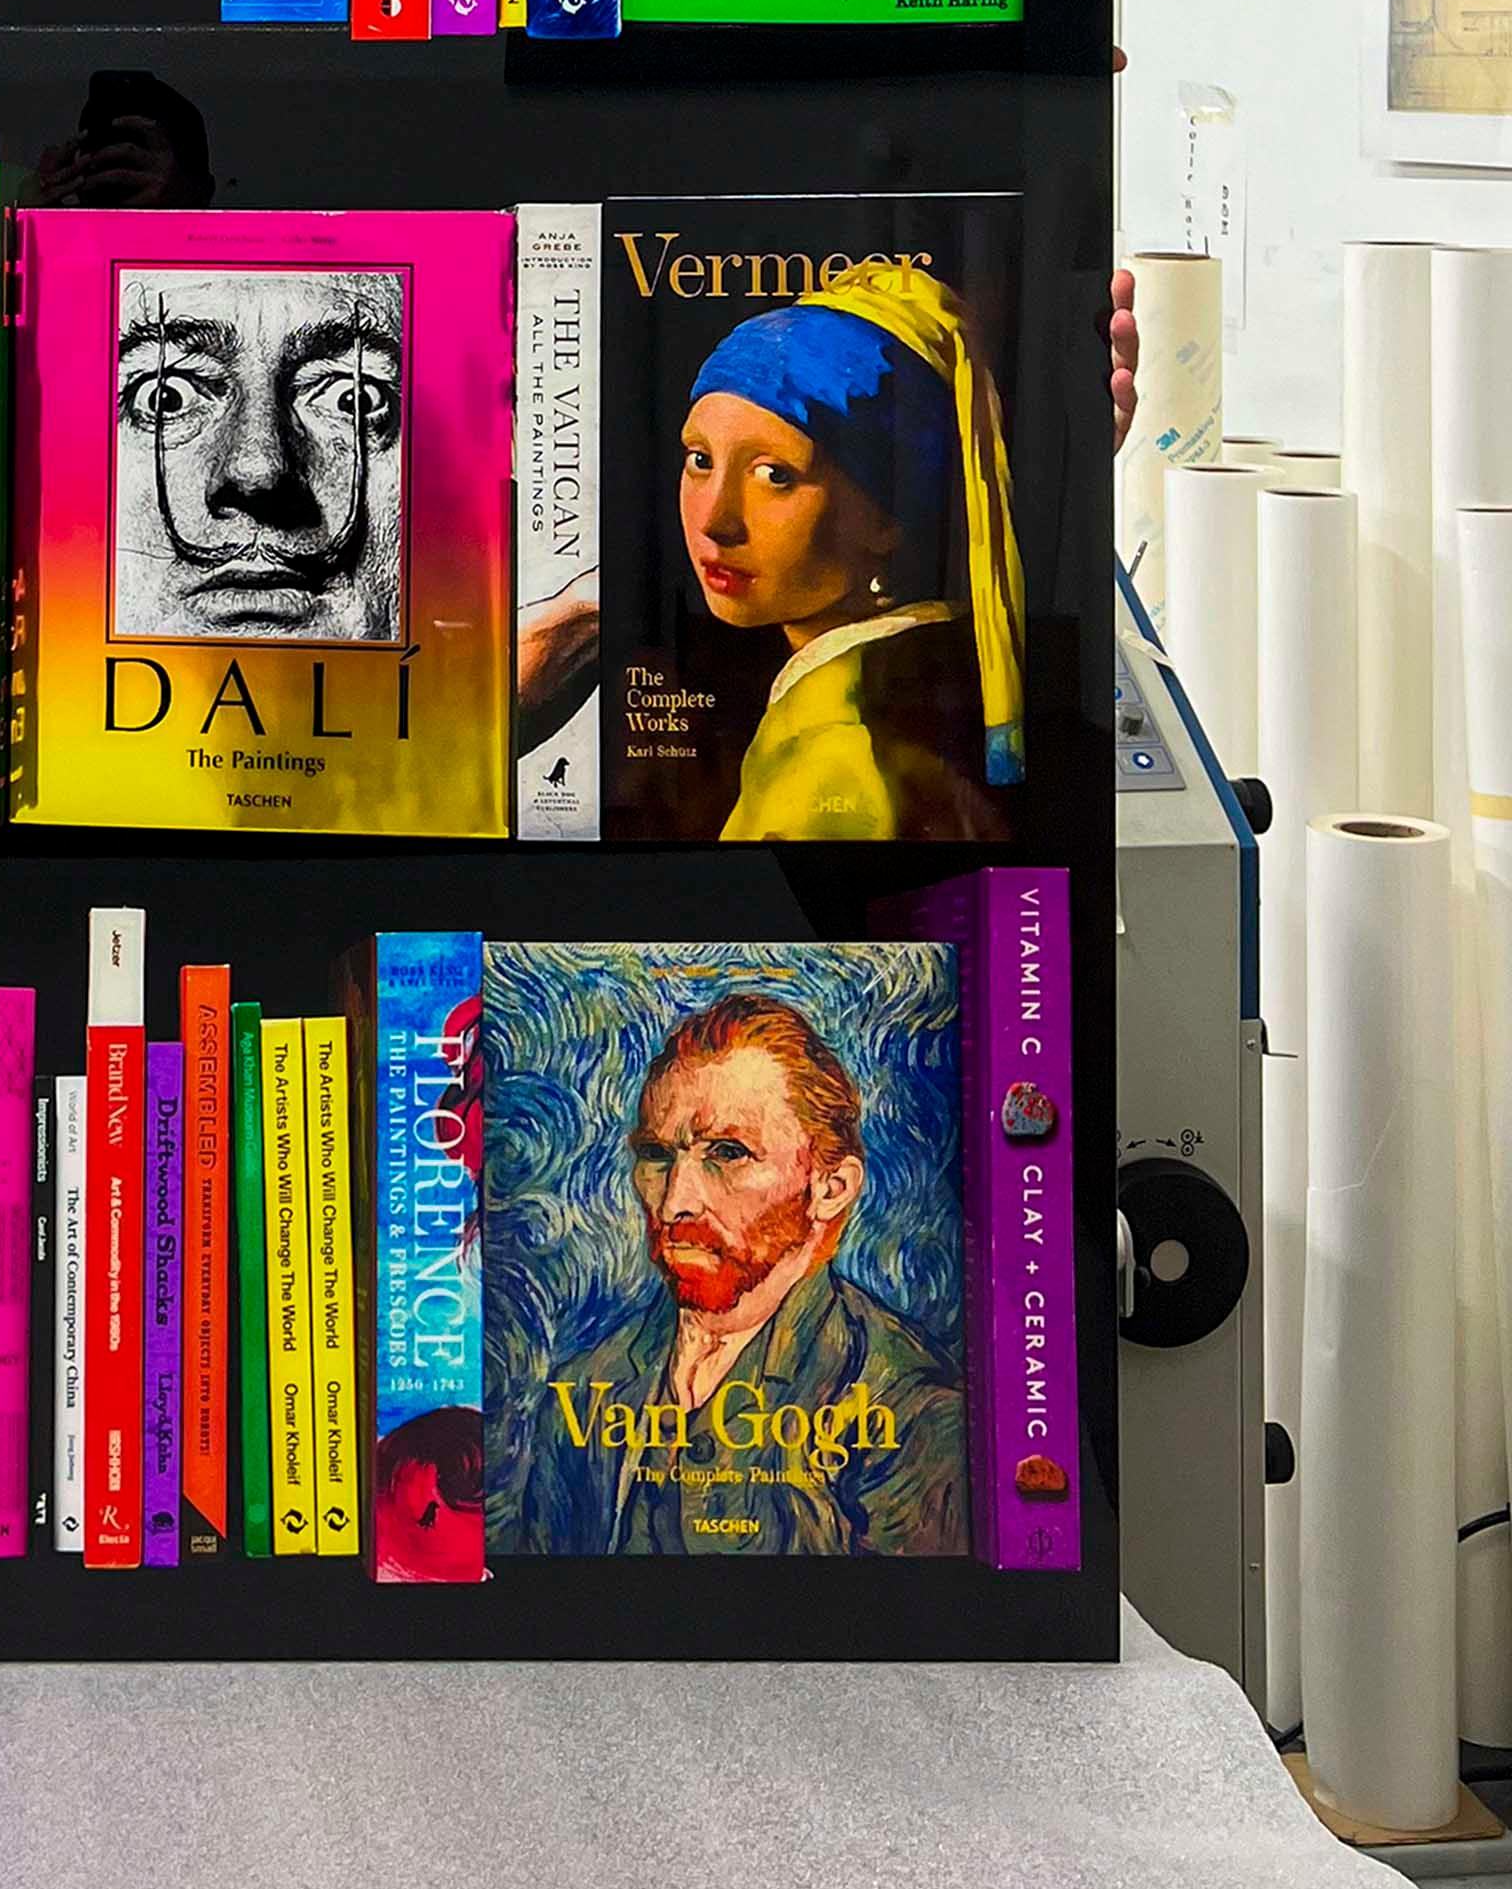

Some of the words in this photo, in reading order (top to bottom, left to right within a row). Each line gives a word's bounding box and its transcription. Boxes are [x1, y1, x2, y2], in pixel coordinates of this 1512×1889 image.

[614, 233, 932, 297] Vermeer
[532, 315, 543, 353] ALL
[554, 290, 580, 371] THE
[532, 362, 543, 403] THE
[532, 414, 543, 532] PAINTINGS
[553, 385, 580, 559] VATICAN
[104, 645, 421, 740] DALÍ
[626, 667, 664, 686] The
[627, 689, 716, 712] Complete
[626, 713, 688, 732] Works
[187, 749, 224, 769] The
[231, 750, 325, 775] Paintings
[227, 793, 292, 808] TASCHEN
[1020, 889, 1040, 1019] VITAMIN
[1021, 1038, 1041, 1055] C
[67, 1187, 80, 1215] The
[413, 1031, 466, 1367] FLORENCE
[1023, 1165, 1043, 1244] CLAY
[67, 1218, 80, 1239] Art
[67, 1242, 80, 1259] of
[1026, 1261, 1039, 1274] +
[63, 1261, 79, 1360] Contemporary
[1024, 1292, 1047, 1438] CERAMIC
[66, 1366, 79, 1409] China
[547, 1382, 692, 1448] Van
[711, 1380, 901, 1472] Gogh
[693, 1520, 760, 1533] TASCHEN
